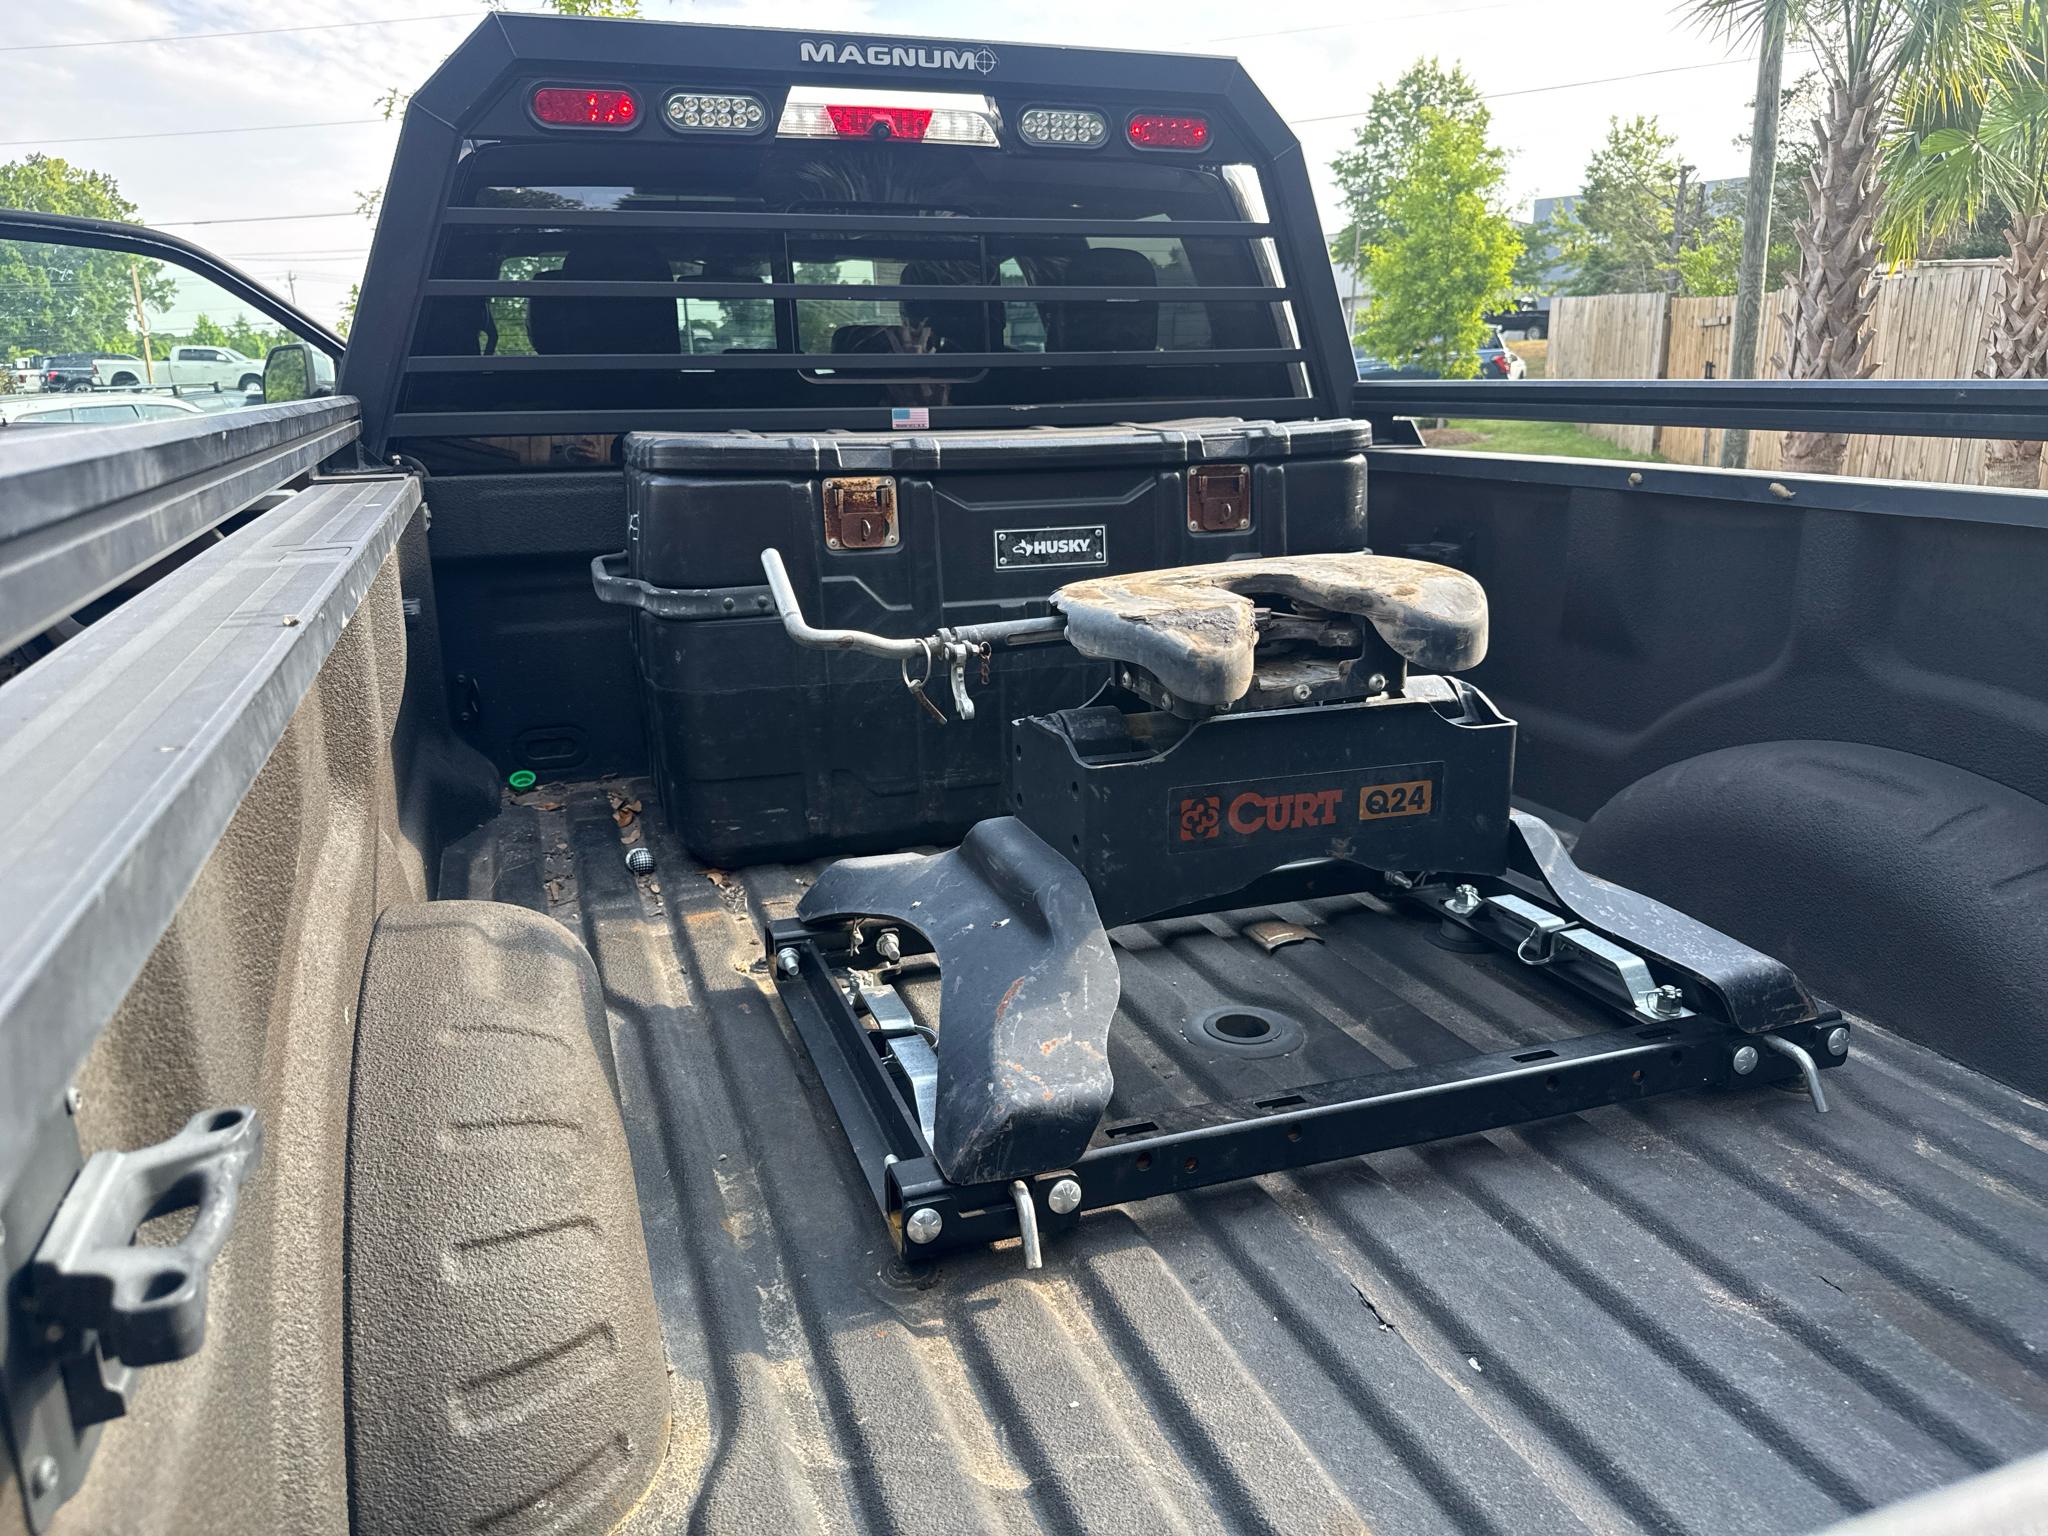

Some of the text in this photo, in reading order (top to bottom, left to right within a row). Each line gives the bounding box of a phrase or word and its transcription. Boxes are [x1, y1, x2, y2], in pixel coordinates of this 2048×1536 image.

[800, 42, 975, 70] MAGNUM
[1033, 539, 1090, 554] HUSKY
[1227, 785, 1425, 834] CURT Q24
